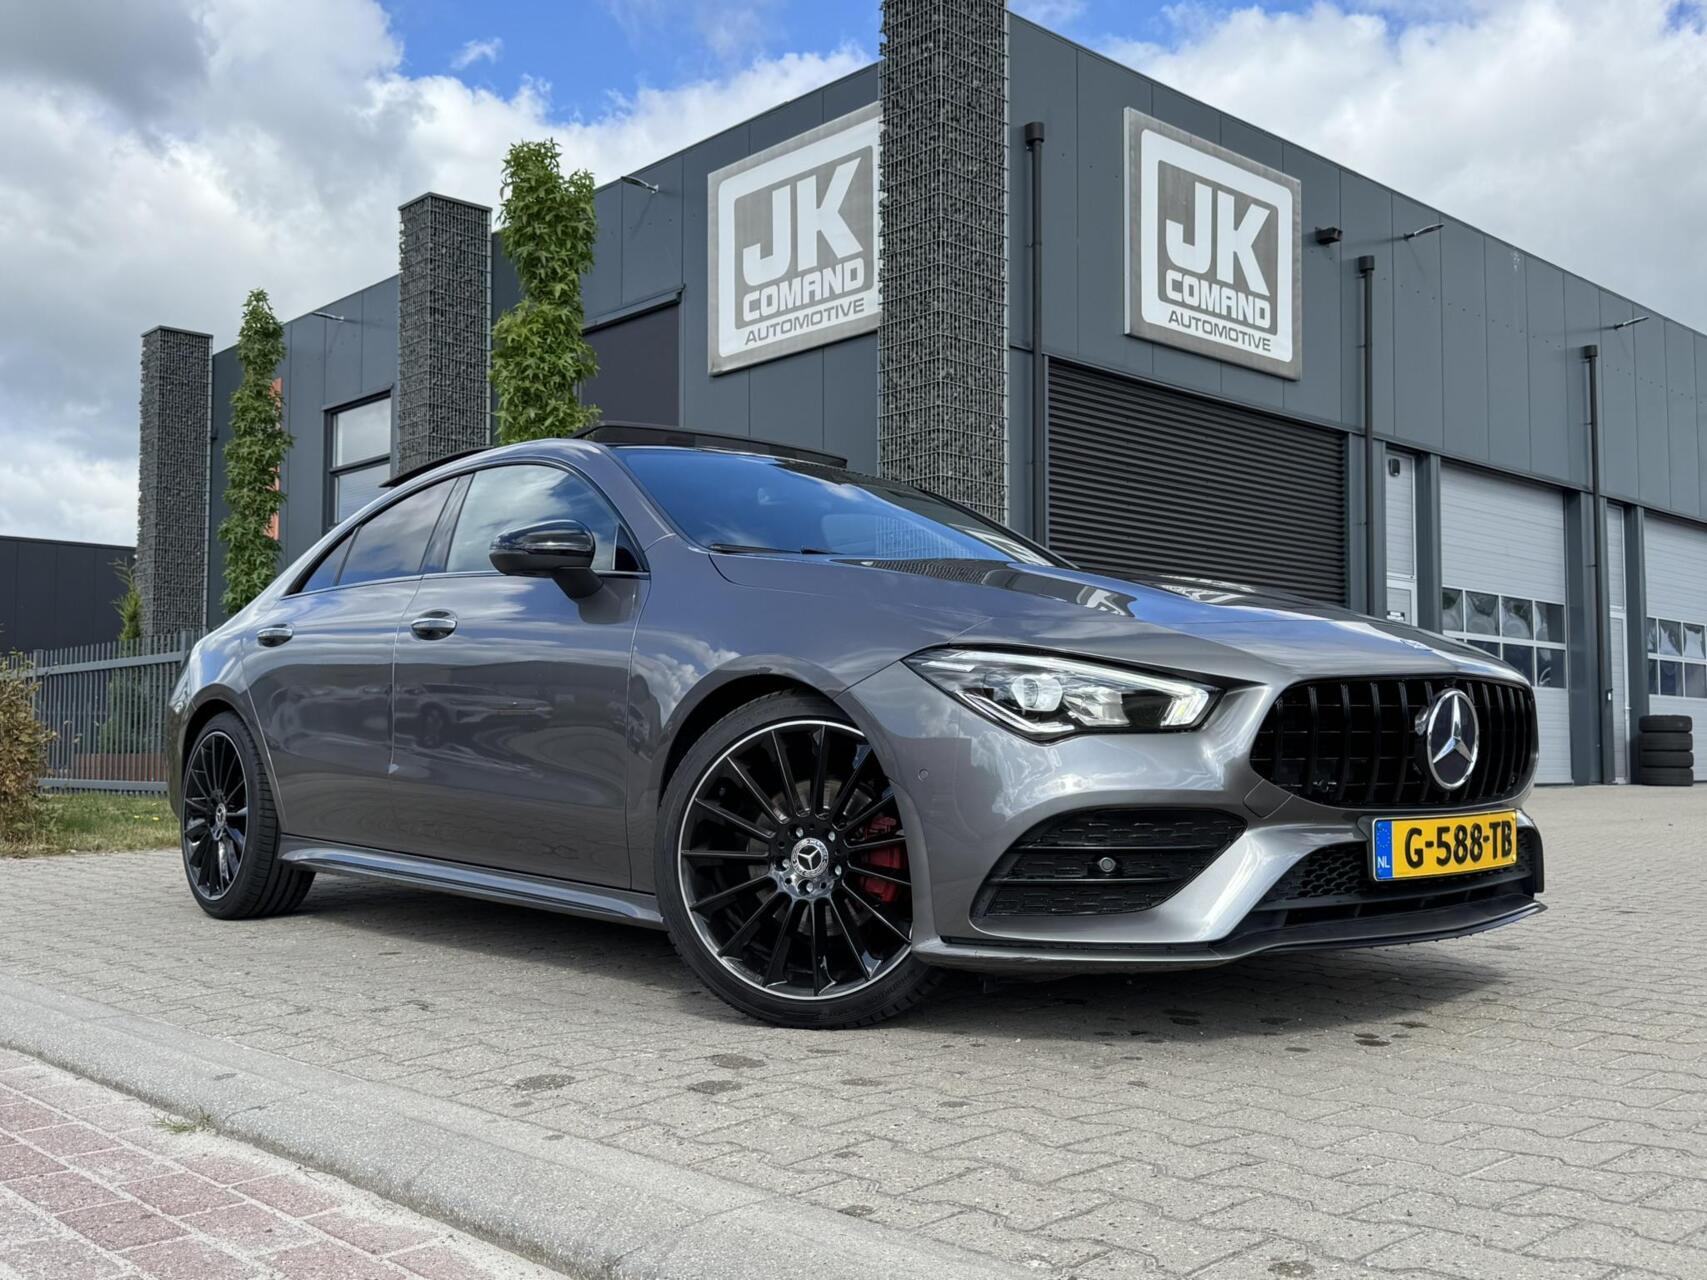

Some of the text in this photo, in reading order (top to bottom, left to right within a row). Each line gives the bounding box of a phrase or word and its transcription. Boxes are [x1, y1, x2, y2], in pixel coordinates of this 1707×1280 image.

[742, 157, 864, 287] JK
[1165, 181, 1271, 297] JK
[742, 257, 865, 322] COMAND
[1165, 268, 1271, 329] COMAND
[744, 297, 865, 346] AUTOMOTIVE
[1168, 310, 1271, 352] AUTOMOTIVE
[1377, 855, 1391, 869] NL
[1404, 820, 1512, 869] G-588-TB
